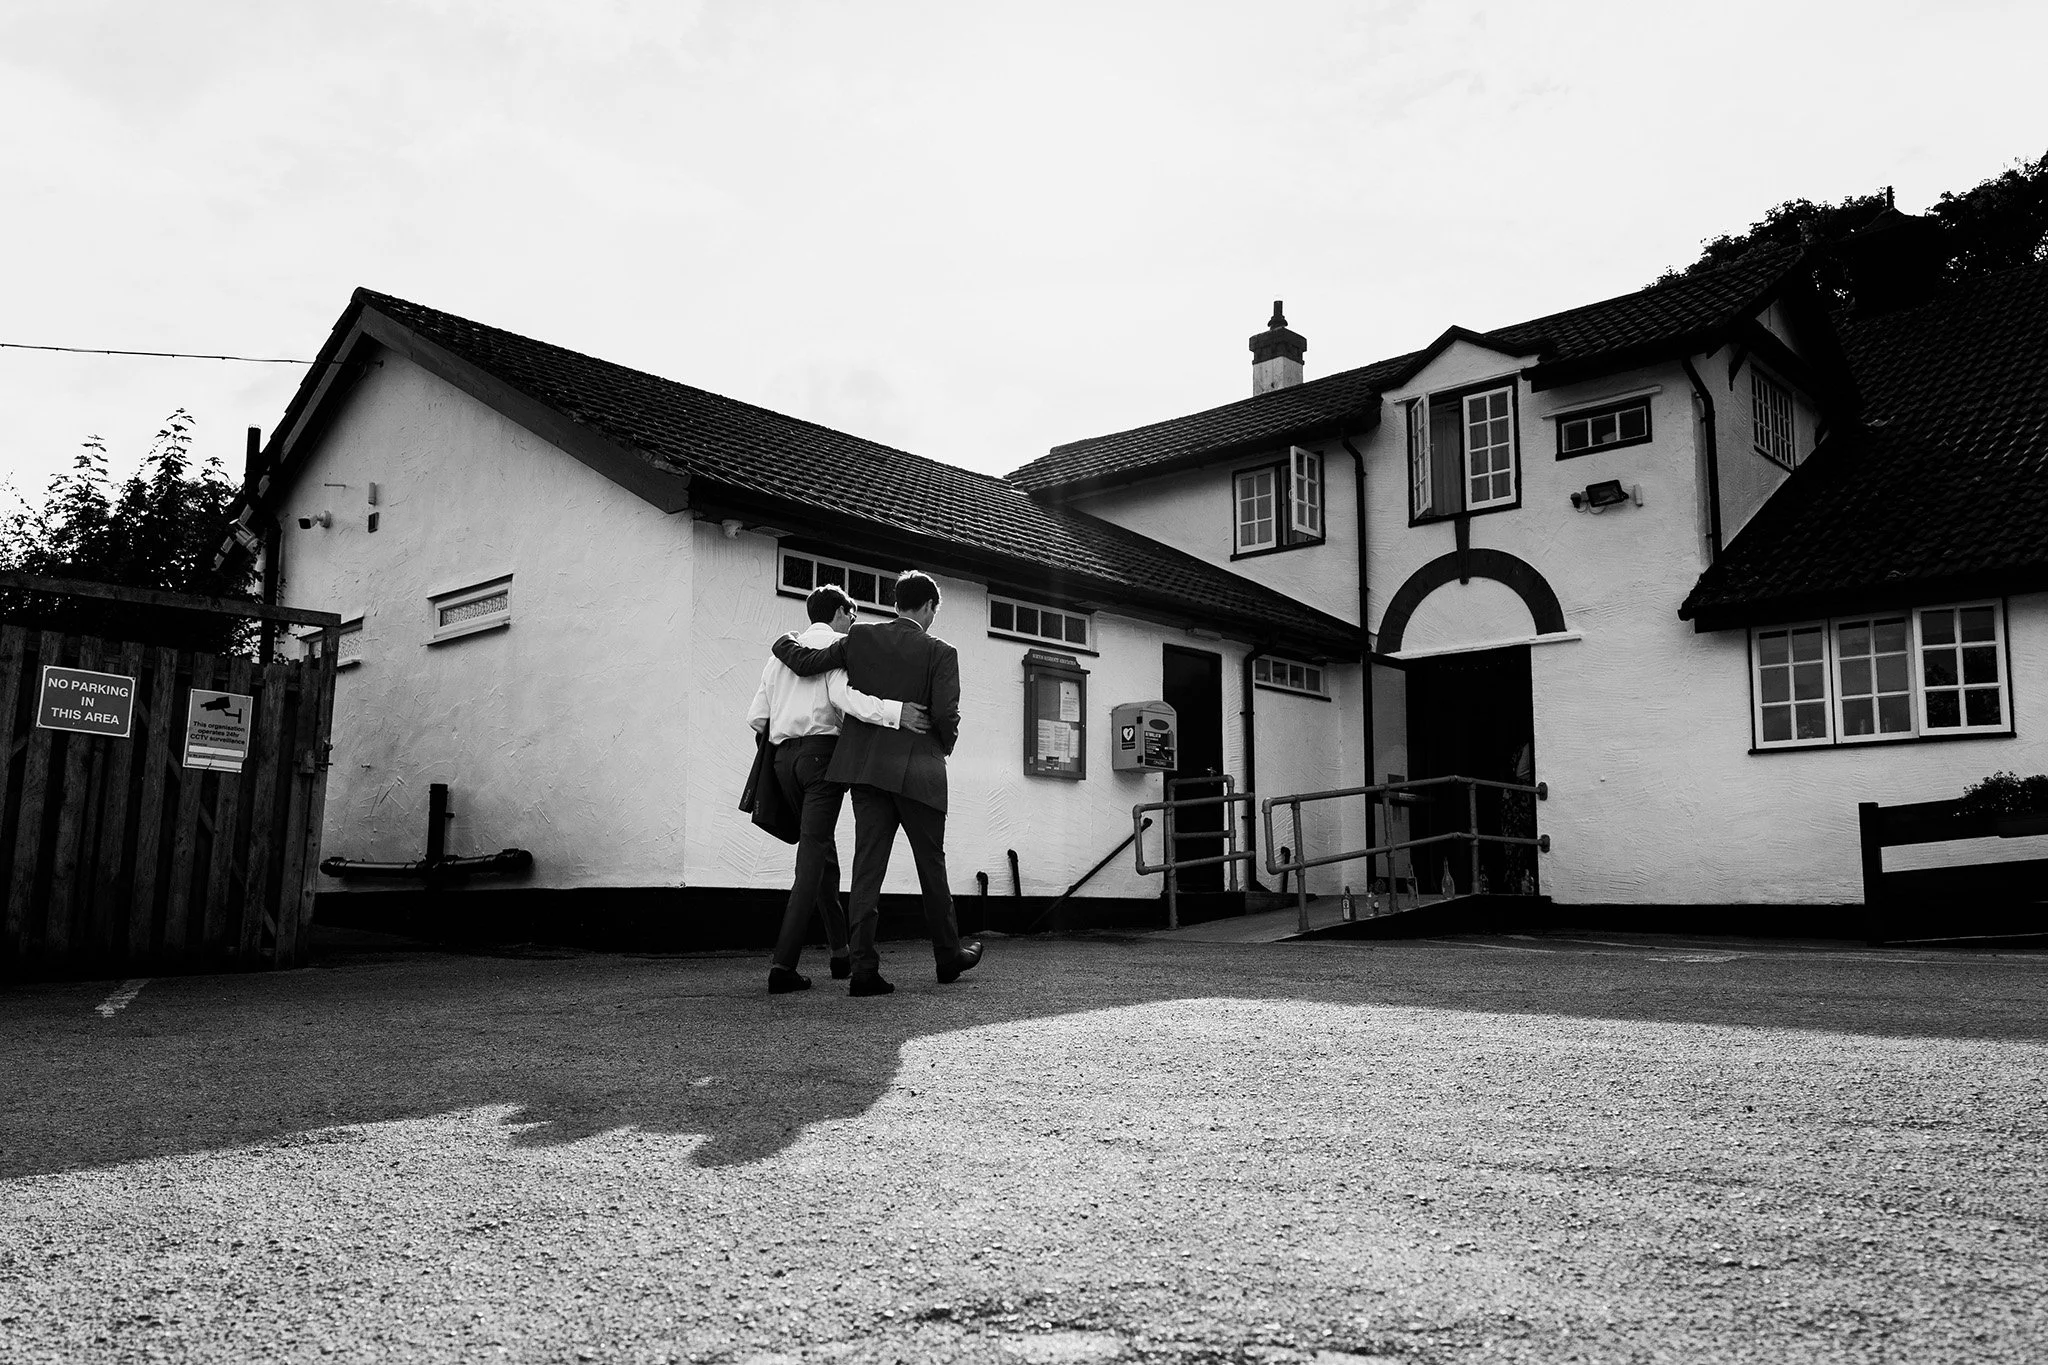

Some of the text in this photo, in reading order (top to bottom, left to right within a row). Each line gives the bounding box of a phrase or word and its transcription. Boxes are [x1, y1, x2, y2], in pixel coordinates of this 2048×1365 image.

[48, 677, 129, 698] NO PARKING
[81, 696, 95, 707] IN
[51, 707, 120, 725] THIS AREA
[193, 720, 207, 728] This
[209, 736, 245, 745] surveillance
